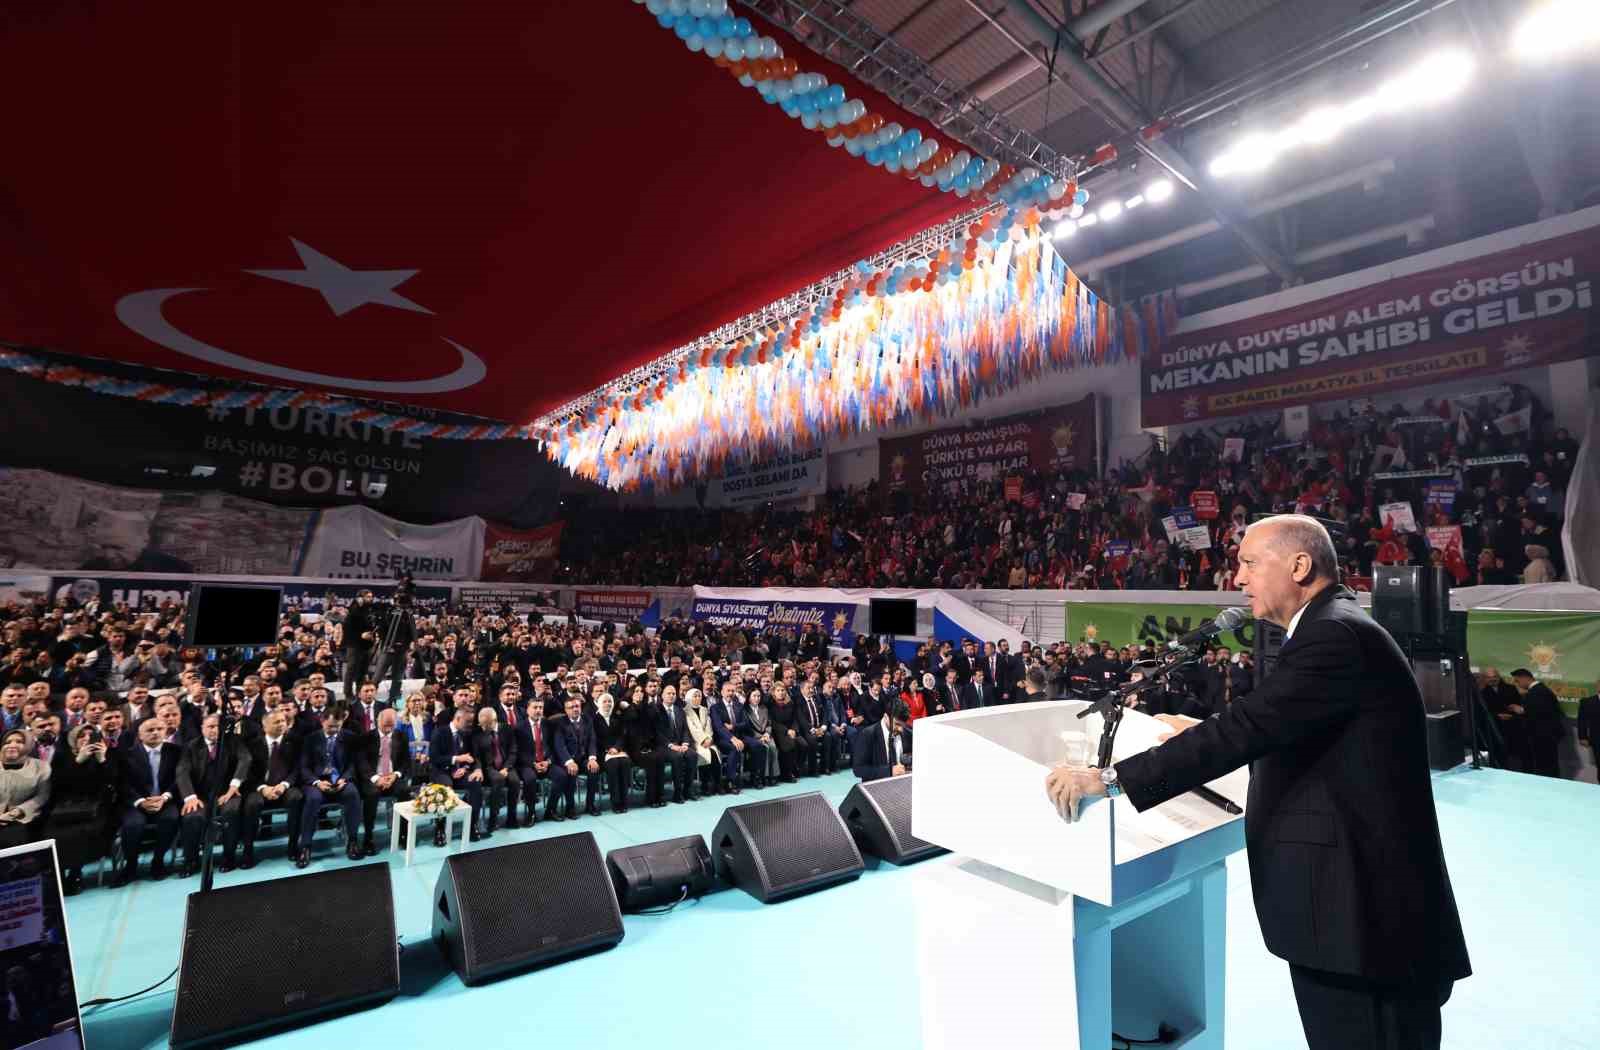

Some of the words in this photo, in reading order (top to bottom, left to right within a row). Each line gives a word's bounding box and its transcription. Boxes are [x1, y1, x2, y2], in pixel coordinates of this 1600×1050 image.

[1161, 340, 1233, 367] DÜNYA
[1237, 314, 1336, 352] DUYSUN
[1344, 295, 1422, 328] ALEM
[1429, 256, 1574, 307] GÖRSÜN
[1150, 347, 1289, 393] MEKANIN
[922, 433, 961, 450] DÜNYA
[354, 453, 421, 474] OLSUN
[341, 550, 371, 568] BU
[696, 603, 720, 614] DÜNYA
